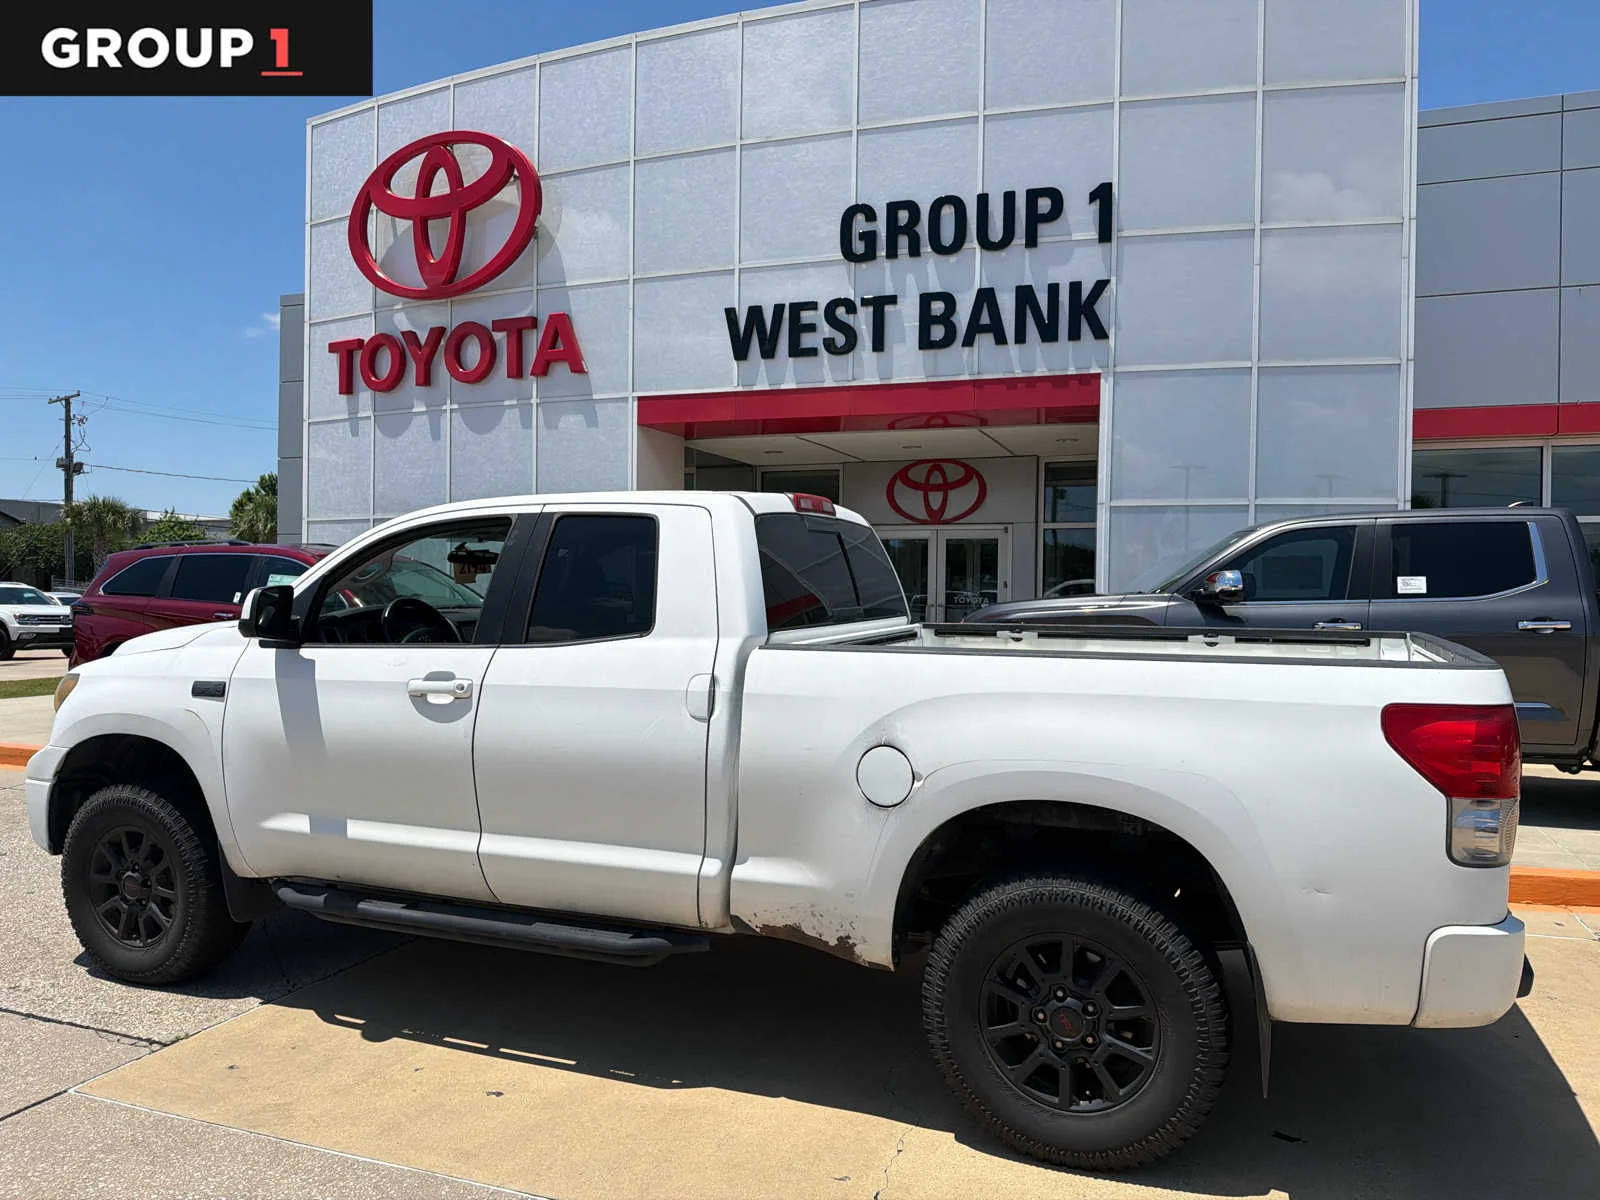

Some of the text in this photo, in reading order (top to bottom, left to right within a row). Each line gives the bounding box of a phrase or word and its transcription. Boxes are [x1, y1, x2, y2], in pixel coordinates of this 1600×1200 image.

[840, 182, 1113, 263] GROUP 1
[328, 311, 587, 395] TOYOTA
[724, 279, 1111, 361] WEST BANK
[953, 595, 990, 606] TOYOTA
